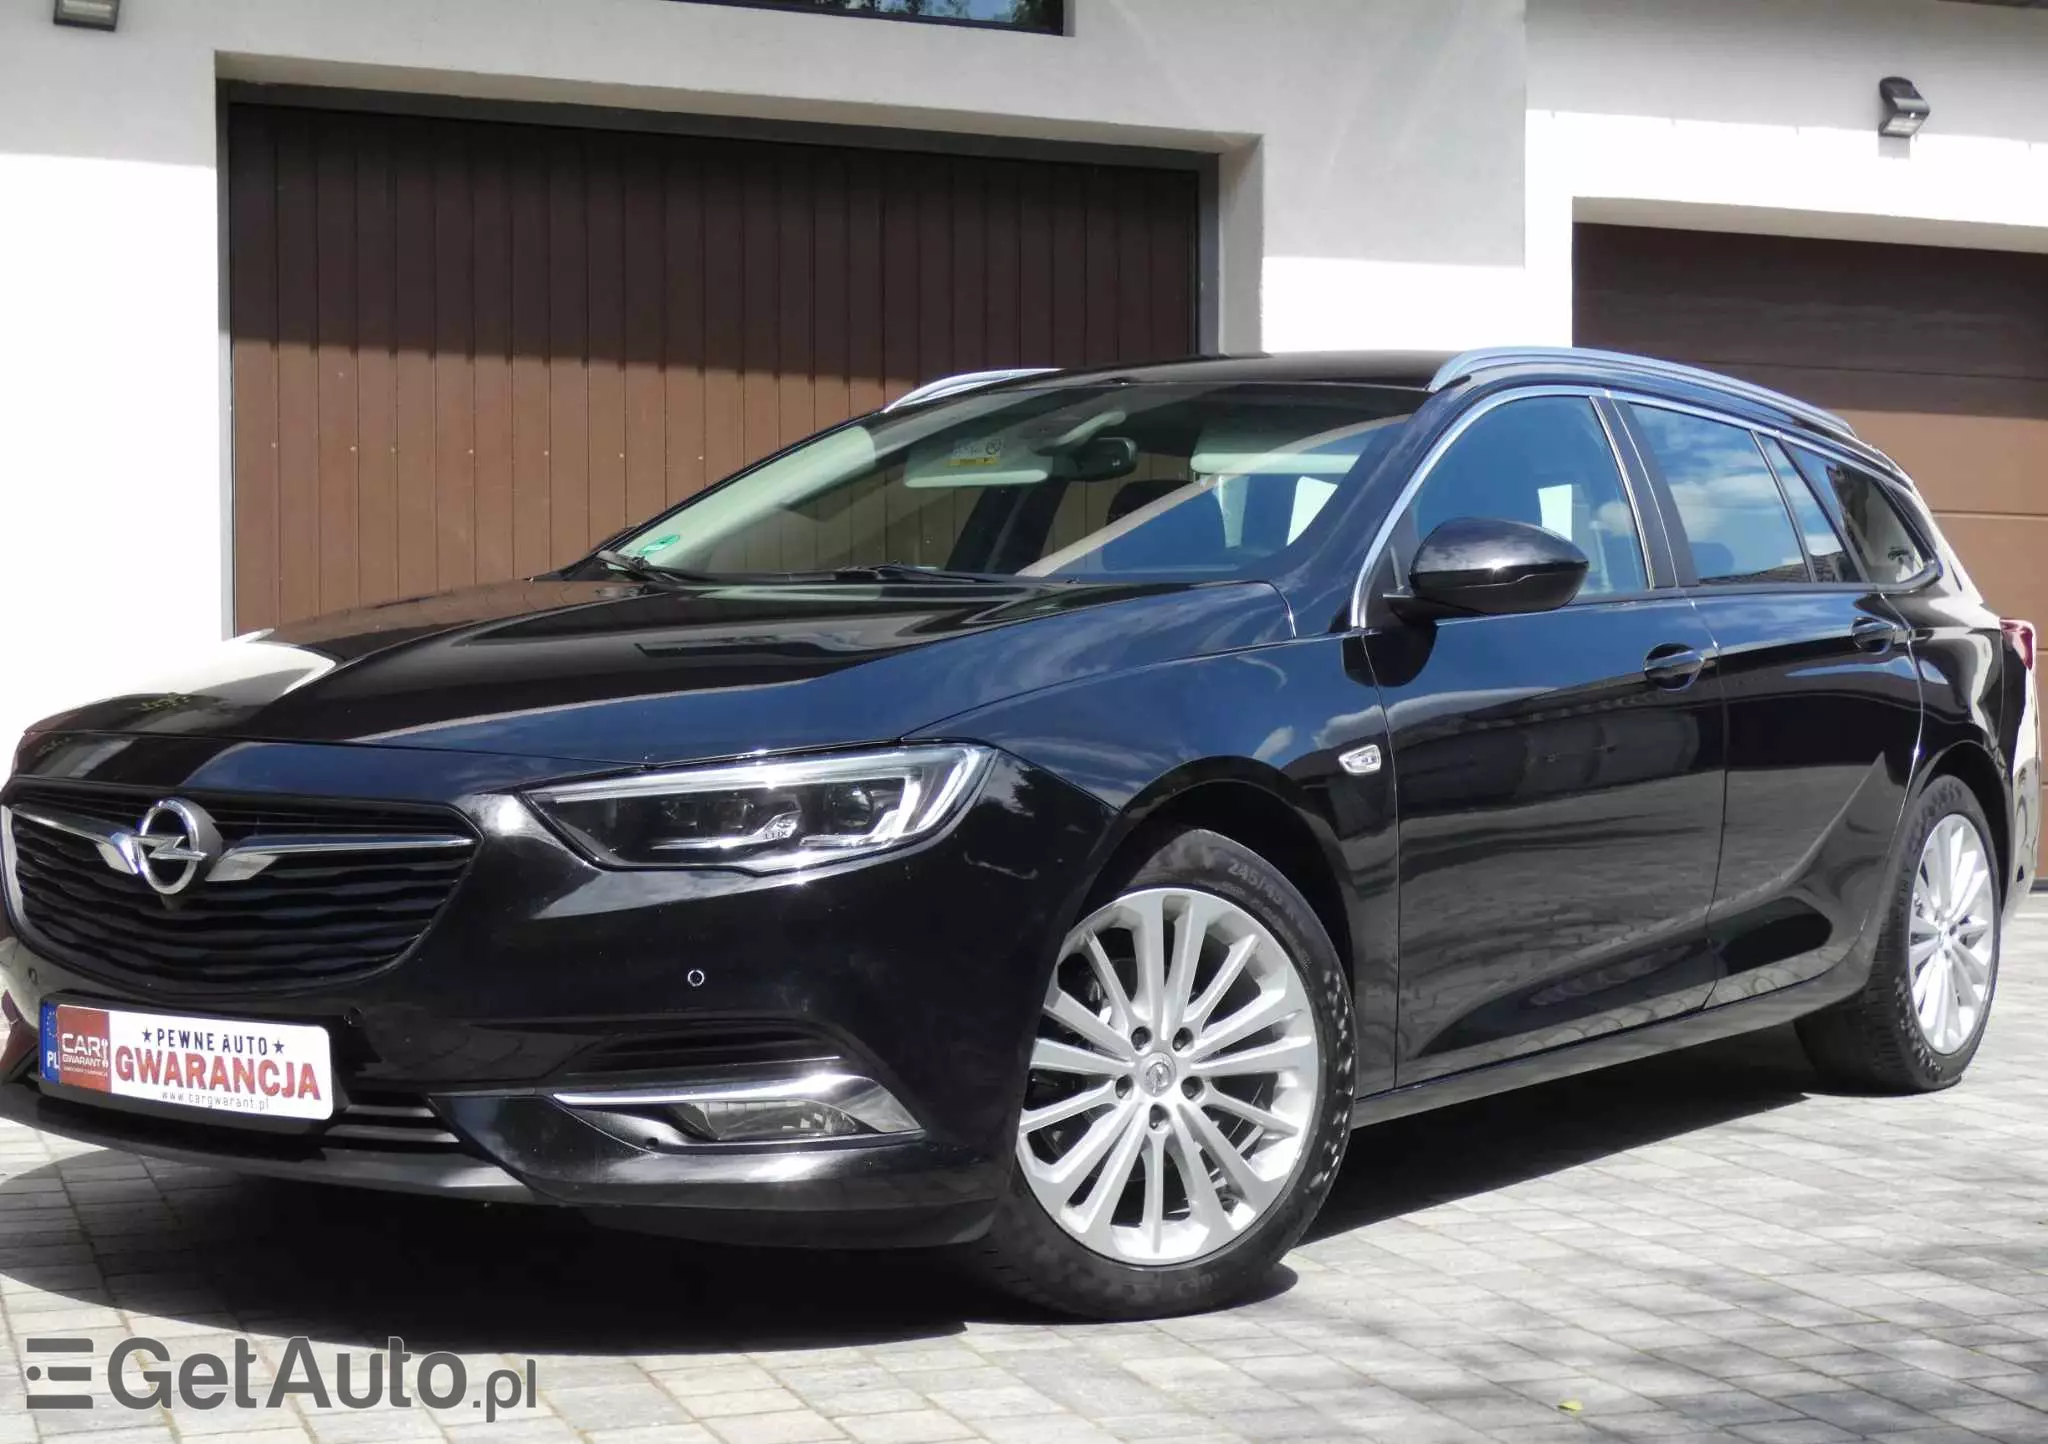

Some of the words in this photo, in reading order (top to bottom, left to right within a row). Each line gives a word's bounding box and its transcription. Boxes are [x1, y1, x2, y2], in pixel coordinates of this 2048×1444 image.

[62, 1033, 102, 1057] CAR
[157, 1028, 214, 1051] PEWNE
[222, 1034, 267, 1055] AUTO
[115, 1045, 321, 1101] GWARANCJA
[162, 1092, 269, 1111] www.cargwarant.pl
